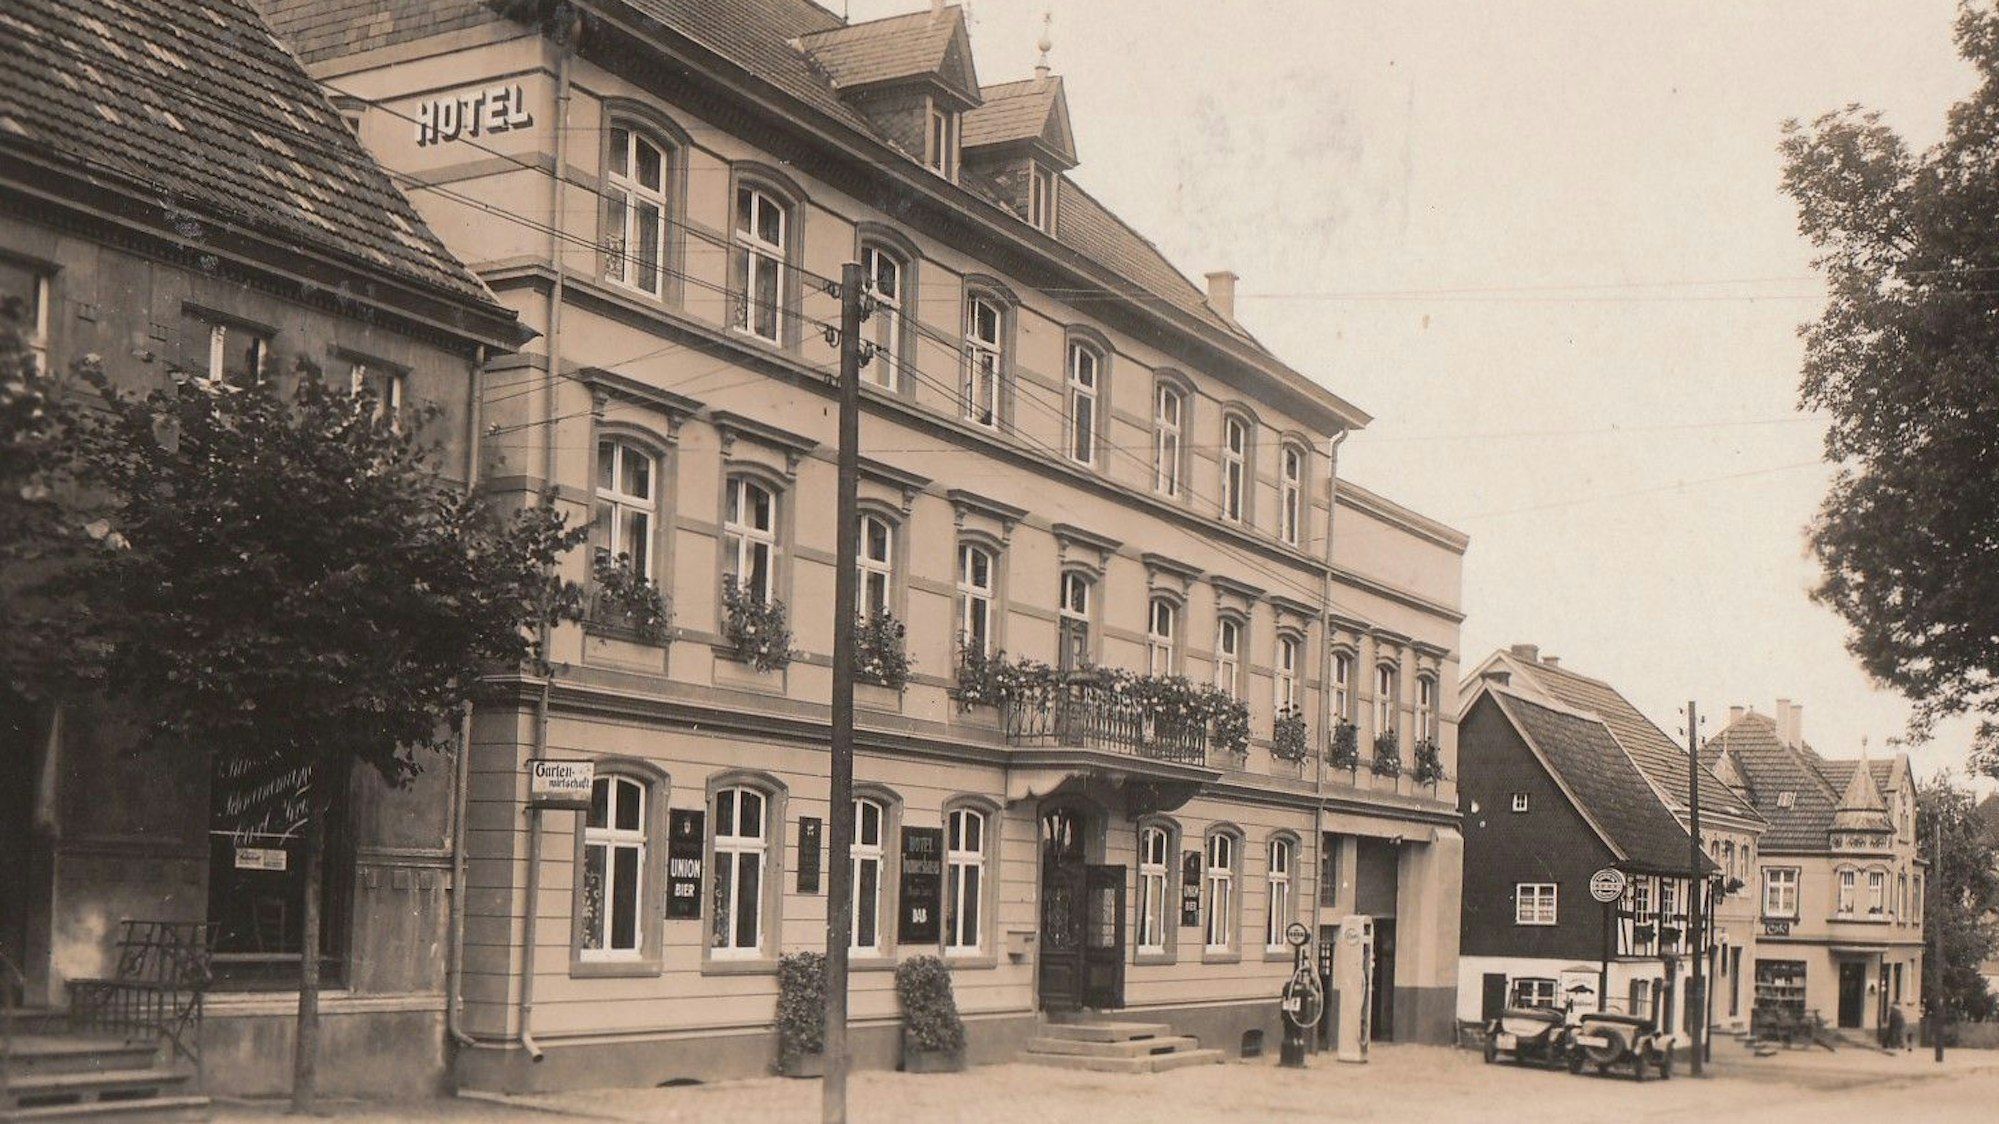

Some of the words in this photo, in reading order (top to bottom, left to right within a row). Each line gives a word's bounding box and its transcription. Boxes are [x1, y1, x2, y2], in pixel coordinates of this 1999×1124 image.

[416, 84, 533, 147] HOTEL
[536, 763, 575, 778] Garten-
[909, 835, 934, 853] HOTEL
[671, 858, 701, 878] UNION
[675, 883, 695, 897] BIER
[912, 908, 928, 923] DAB
